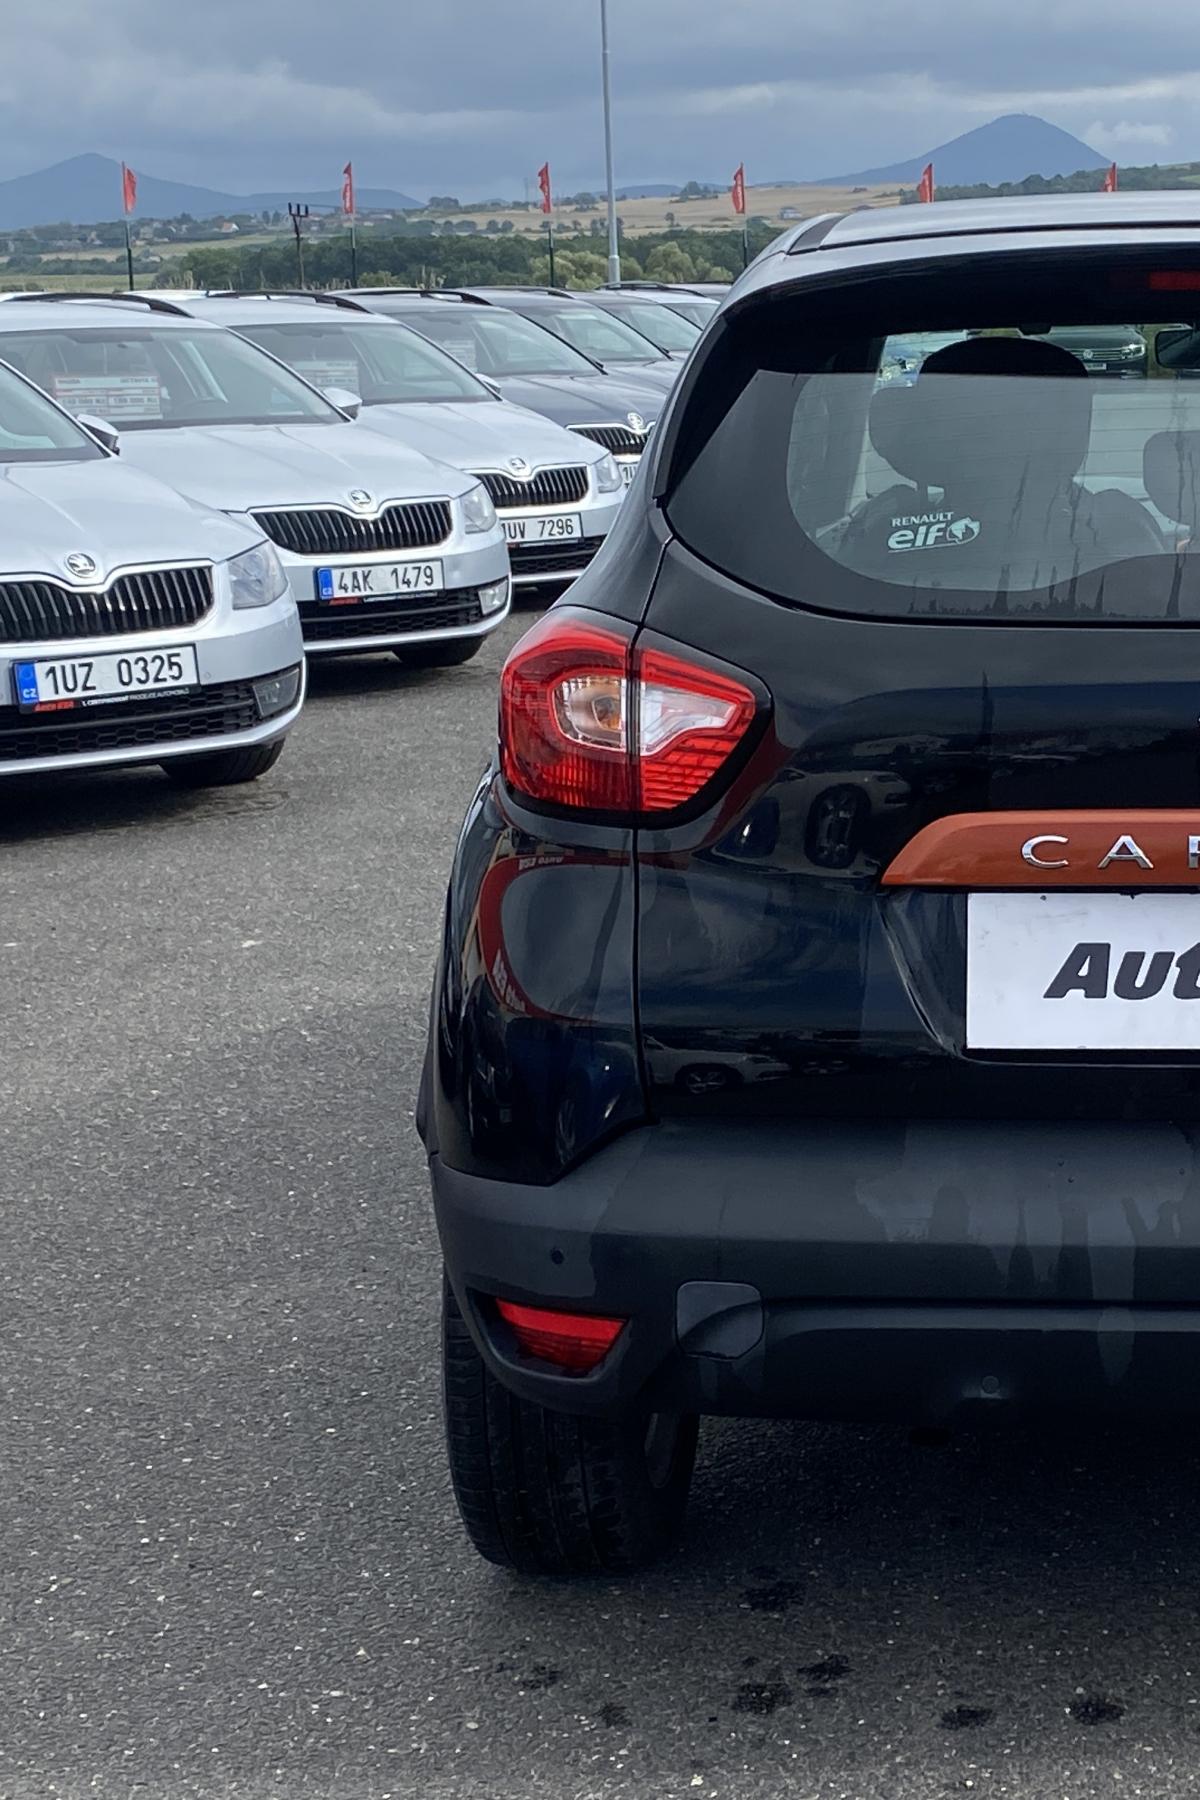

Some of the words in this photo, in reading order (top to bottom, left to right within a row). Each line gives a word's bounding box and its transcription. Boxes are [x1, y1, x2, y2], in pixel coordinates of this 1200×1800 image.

[501, 521, 526, 539] 1UV
[537, 518, 574, 537] 7296
[891, 511, 954, 527] RENAULT
[887, 522, 946, 549] elf
[337, 569, 374, 593] 4AK
[391, 565, 434, 589] 1479
[45, 661, 96, 695] 1UZ
[117, 652, 183, 686] 0325
